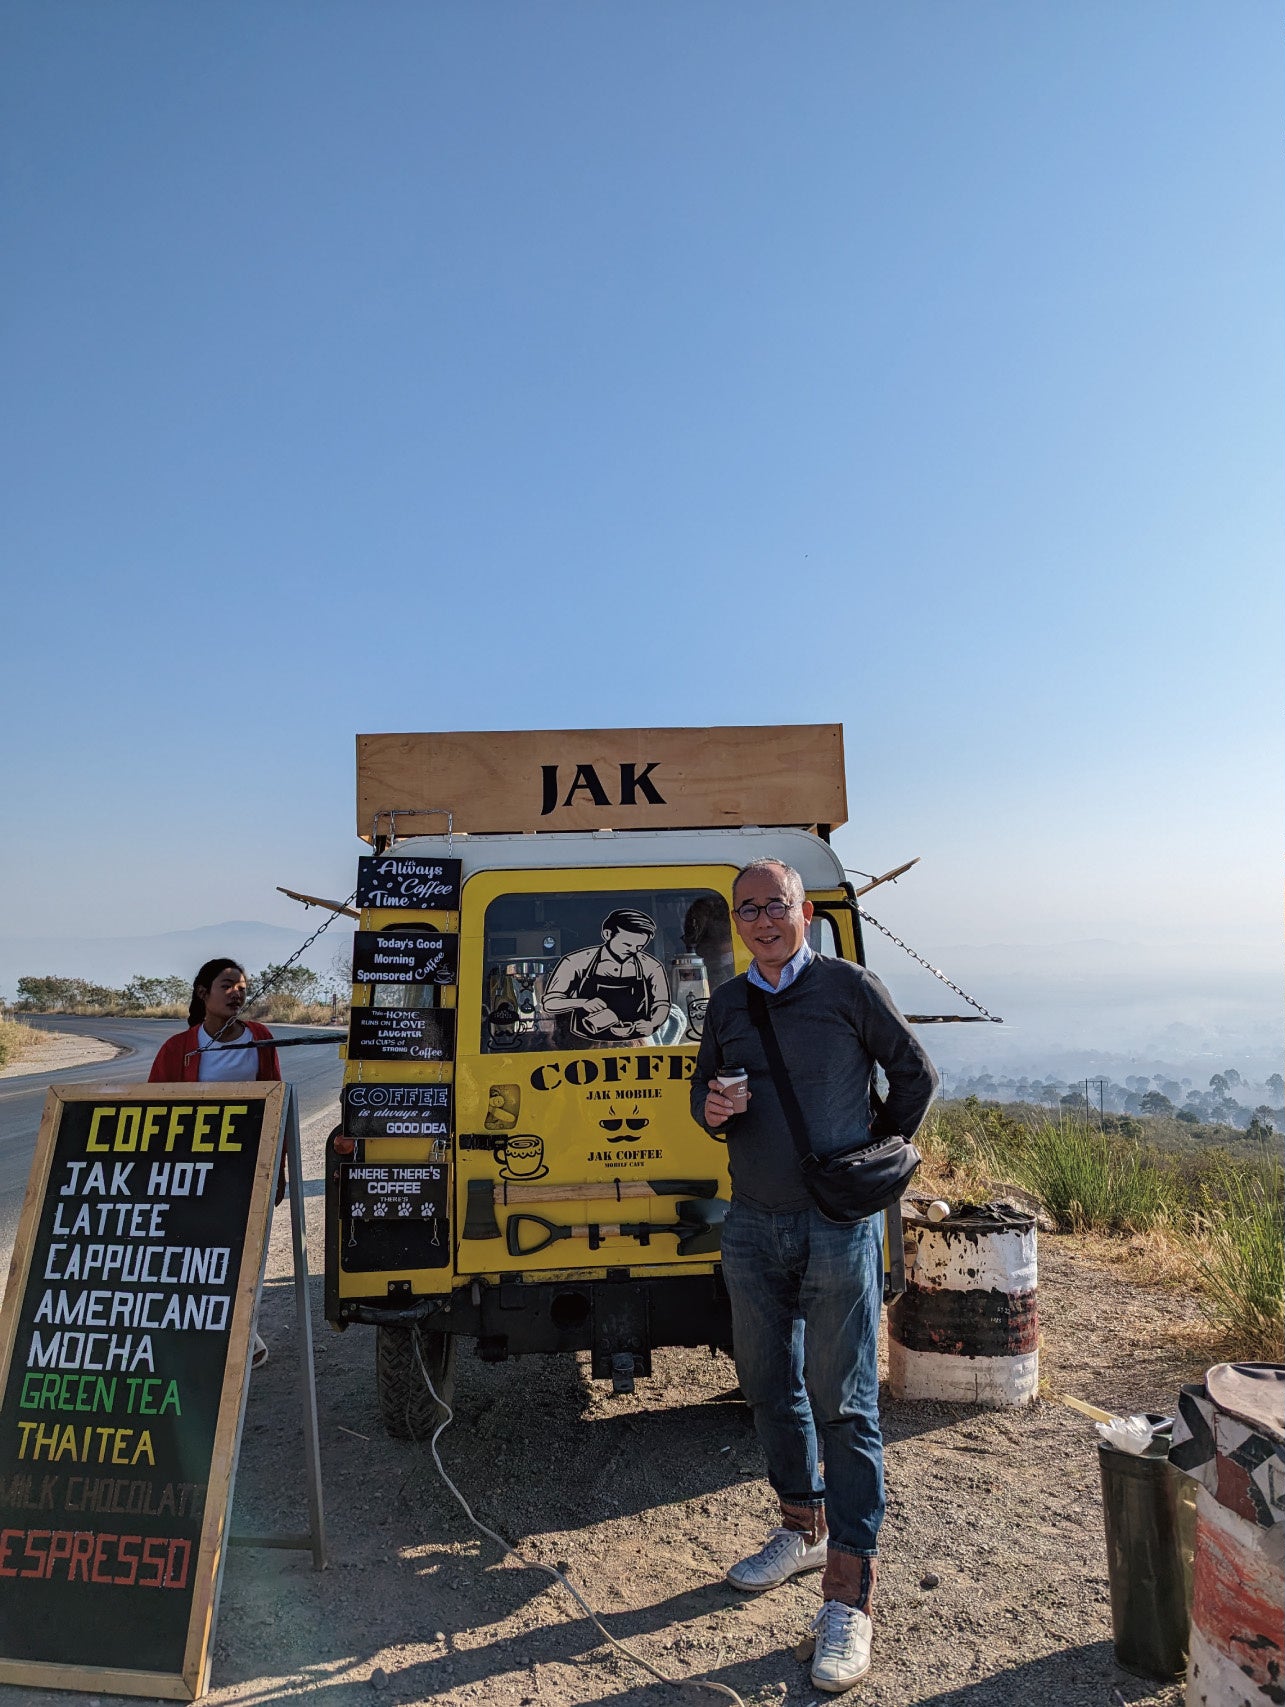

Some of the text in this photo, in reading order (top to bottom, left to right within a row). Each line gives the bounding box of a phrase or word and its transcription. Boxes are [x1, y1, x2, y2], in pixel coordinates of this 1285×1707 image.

[541, 762, 667, 816] JAK
[377, 860, 443, 879] Always
[400, 878, 453, 898] Coffee
[368, 890, 410, 907] Time
[376, 938, 443, 950] Today's Good
[374, 953, 415, 966] Morning
[415, 951, 445, 980] Coffee
[357, 970, 413, 982] Sponsored
[385, 1011, 420, 1019] HOME
[392, 1020, 426, 1029] LOVE
[378, 1030, 422, 1038] LAUGHTER
[409, 1045, 443, 1059] Coffee
[348, 1087, 448, 1106] COFFEE
[586, 1088, 662, 1100] JAK MOBILE
[358, 1108, 370, 1117] is
[373, 1108, 419, 1120] always
[86, 1105, 248, 1152] COFFEE
[386, 1122, 447, 1134] GOOD IDEA
[587, 1149, 663, 1162] JAK COFFEE
[60, 1161, 214, 1196] JAK HOT
[349, 1165, 441, 1180] WHERE THERE'S
[367, 1182, 421, 1194] COFFEE
[52, 1202, 170, 1237] LATTEE
[43, 1243, 231, 1285] CAPPUCCINO
[33, 1289, 231, 1331] AMERICANO
[27, 1331, 155, 1372] MOCHA
[20, 1372, 182, 1416] GREEN TEA
[18, 1421, 156, 1466] THAI TEA
[0, 1529, 192, 1589] ESPRESSO
